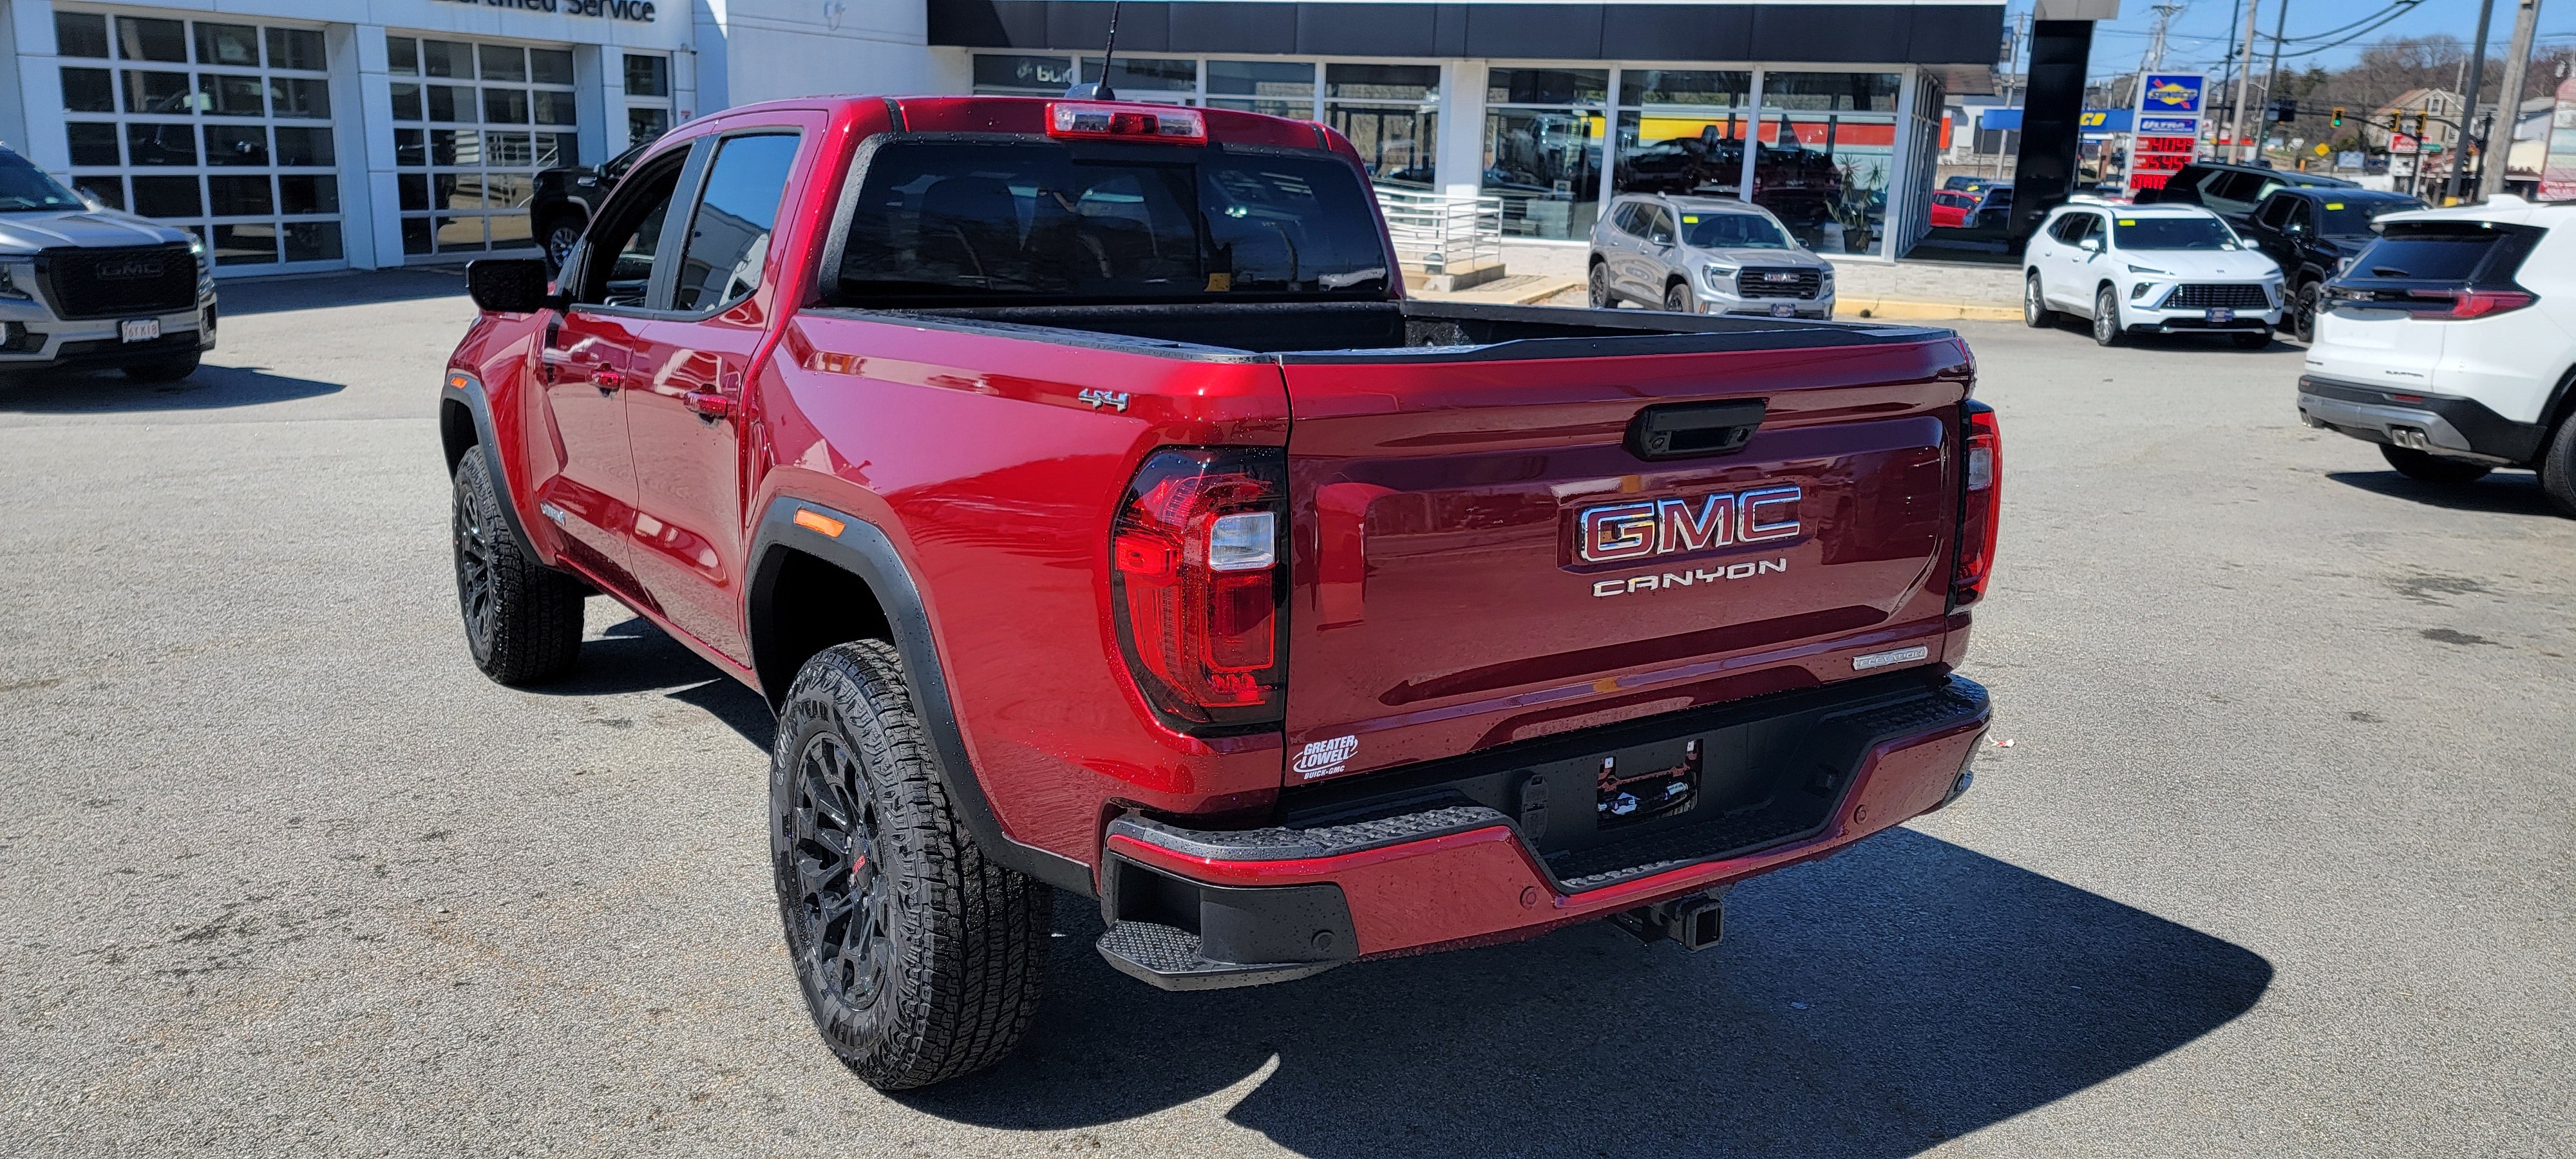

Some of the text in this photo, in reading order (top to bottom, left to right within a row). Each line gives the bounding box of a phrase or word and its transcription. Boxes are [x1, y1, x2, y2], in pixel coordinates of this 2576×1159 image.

[1579, 484, 1802, 562] GMC
[1591, 557, 1788, 598] CANYON
[1859, 649, 1924, 667] ELEVATION
[1303, 735, 1355, 756] GREATER
[1300, 747, 1350, 769] LOWELL
